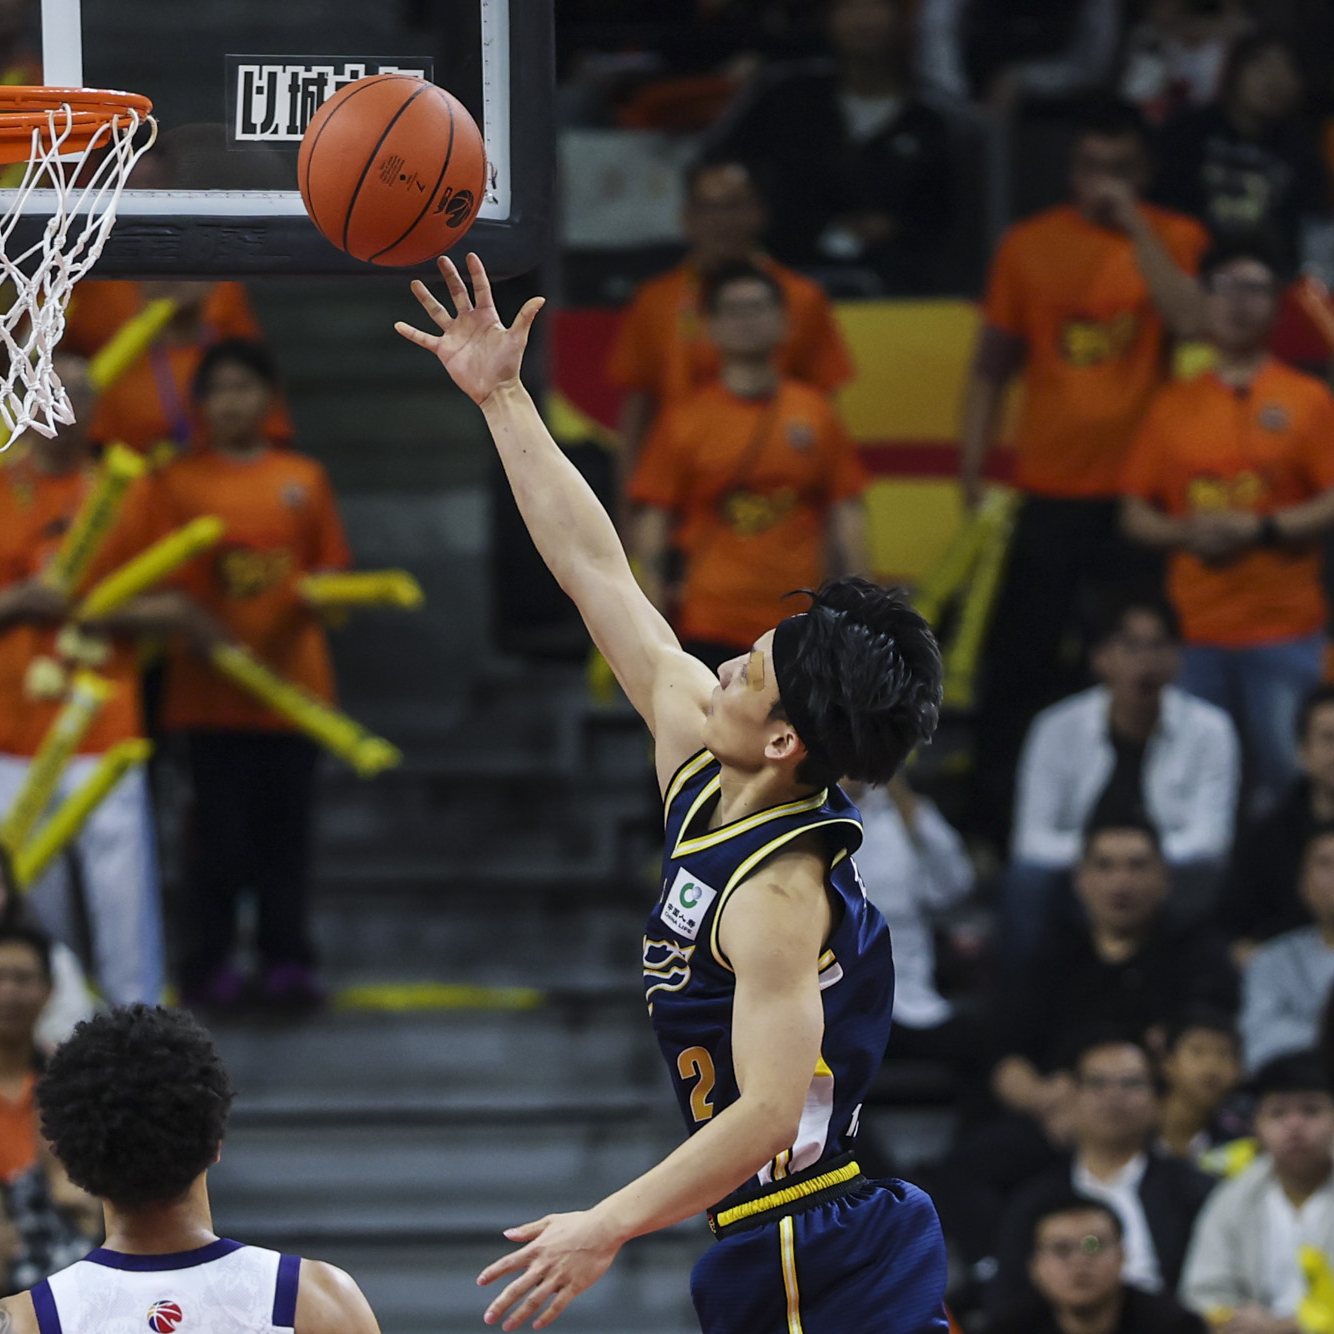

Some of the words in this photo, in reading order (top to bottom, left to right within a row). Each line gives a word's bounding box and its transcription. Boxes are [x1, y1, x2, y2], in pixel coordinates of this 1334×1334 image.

[236, 64, 425, 141] 以城
[667, 903, 696, 928] 中国人寿
[678, 923, 693, 934] LIFE
[676, 1046, 716, 1123] 2
